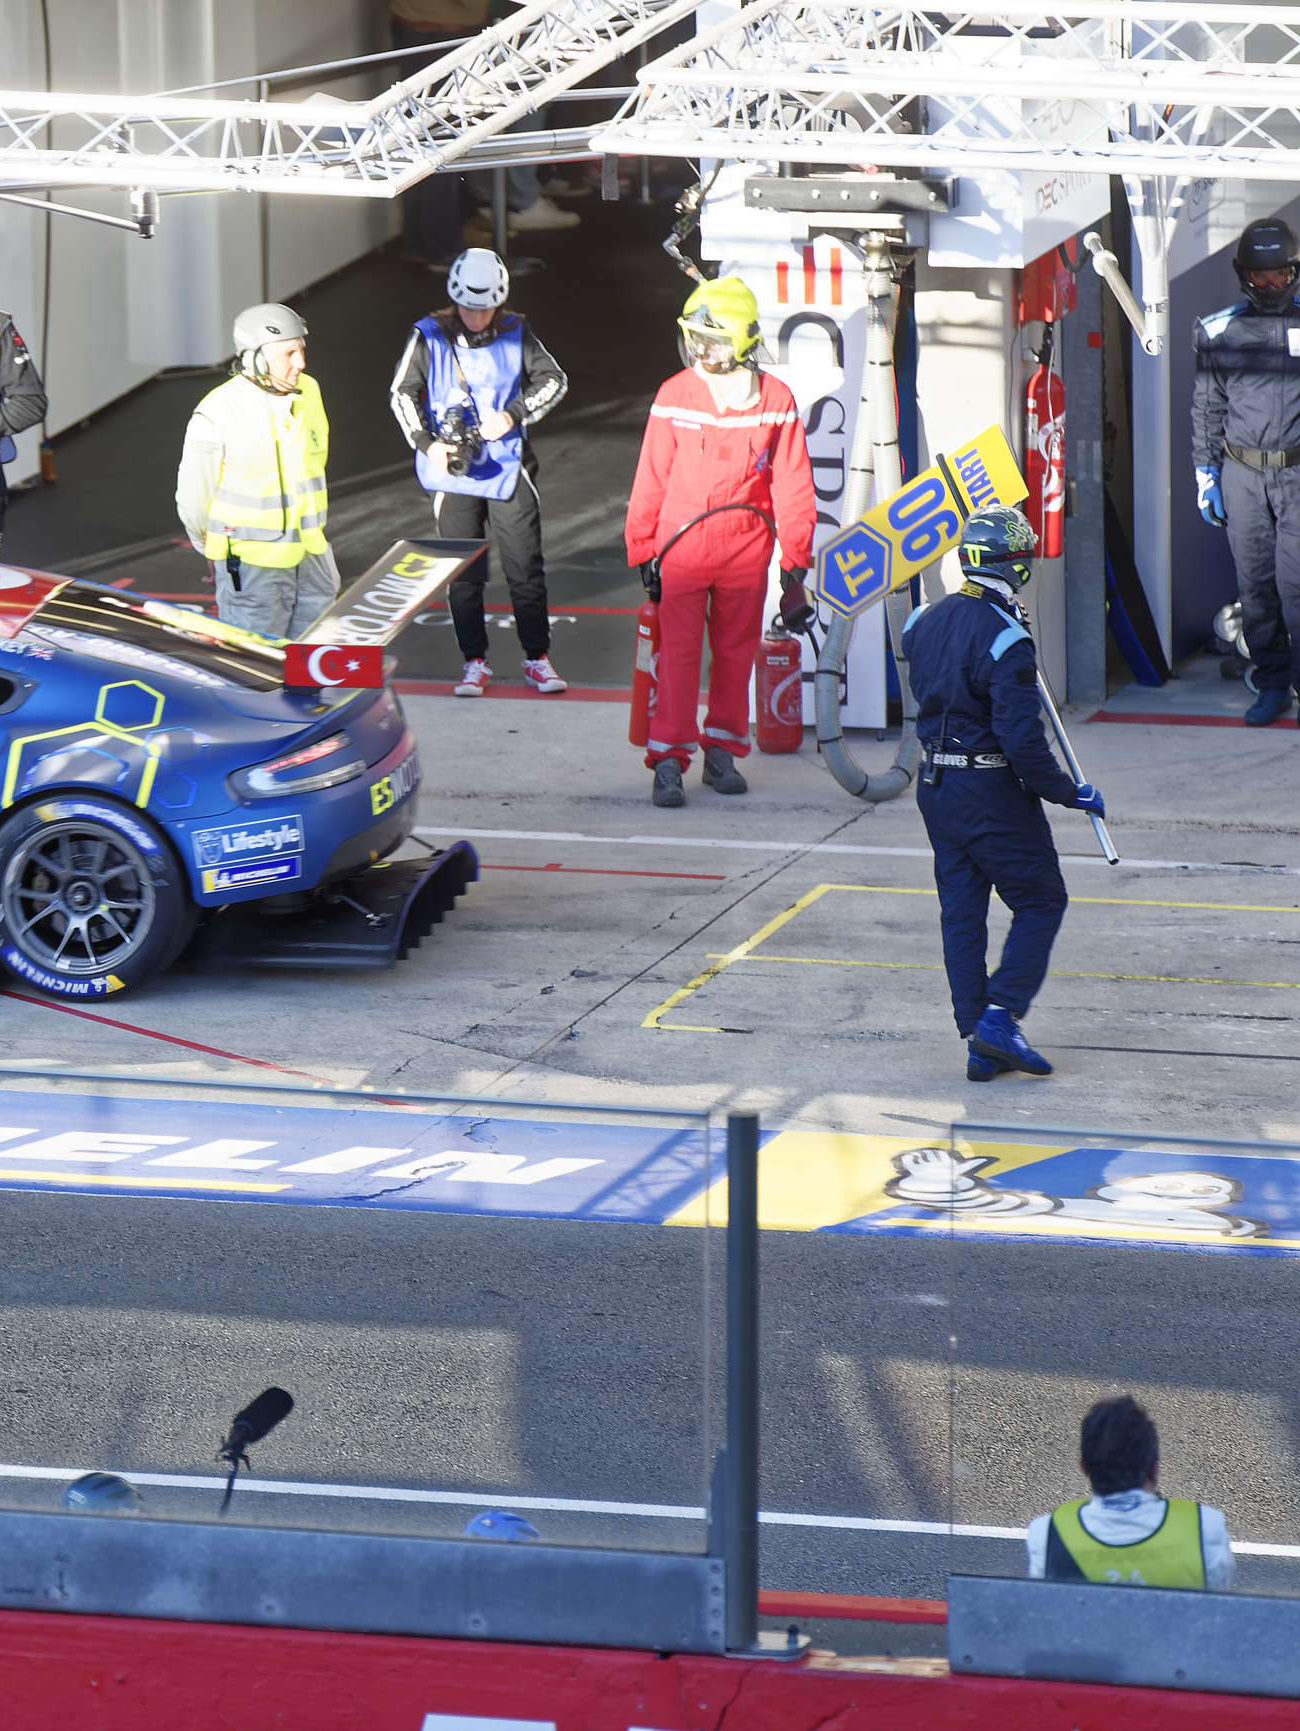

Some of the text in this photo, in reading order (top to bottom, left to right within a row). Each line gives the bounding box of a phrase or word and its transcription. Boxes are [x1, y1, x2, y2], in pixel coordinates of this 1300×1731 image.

[888, 478, 959, 563] 90
[834, 549, 875, 598] TF
[932, 752, 968, 767] GLOVES
[222, 824, 301, 854] Lifestyle
[7, 950, 90, 995] MICHELIN
